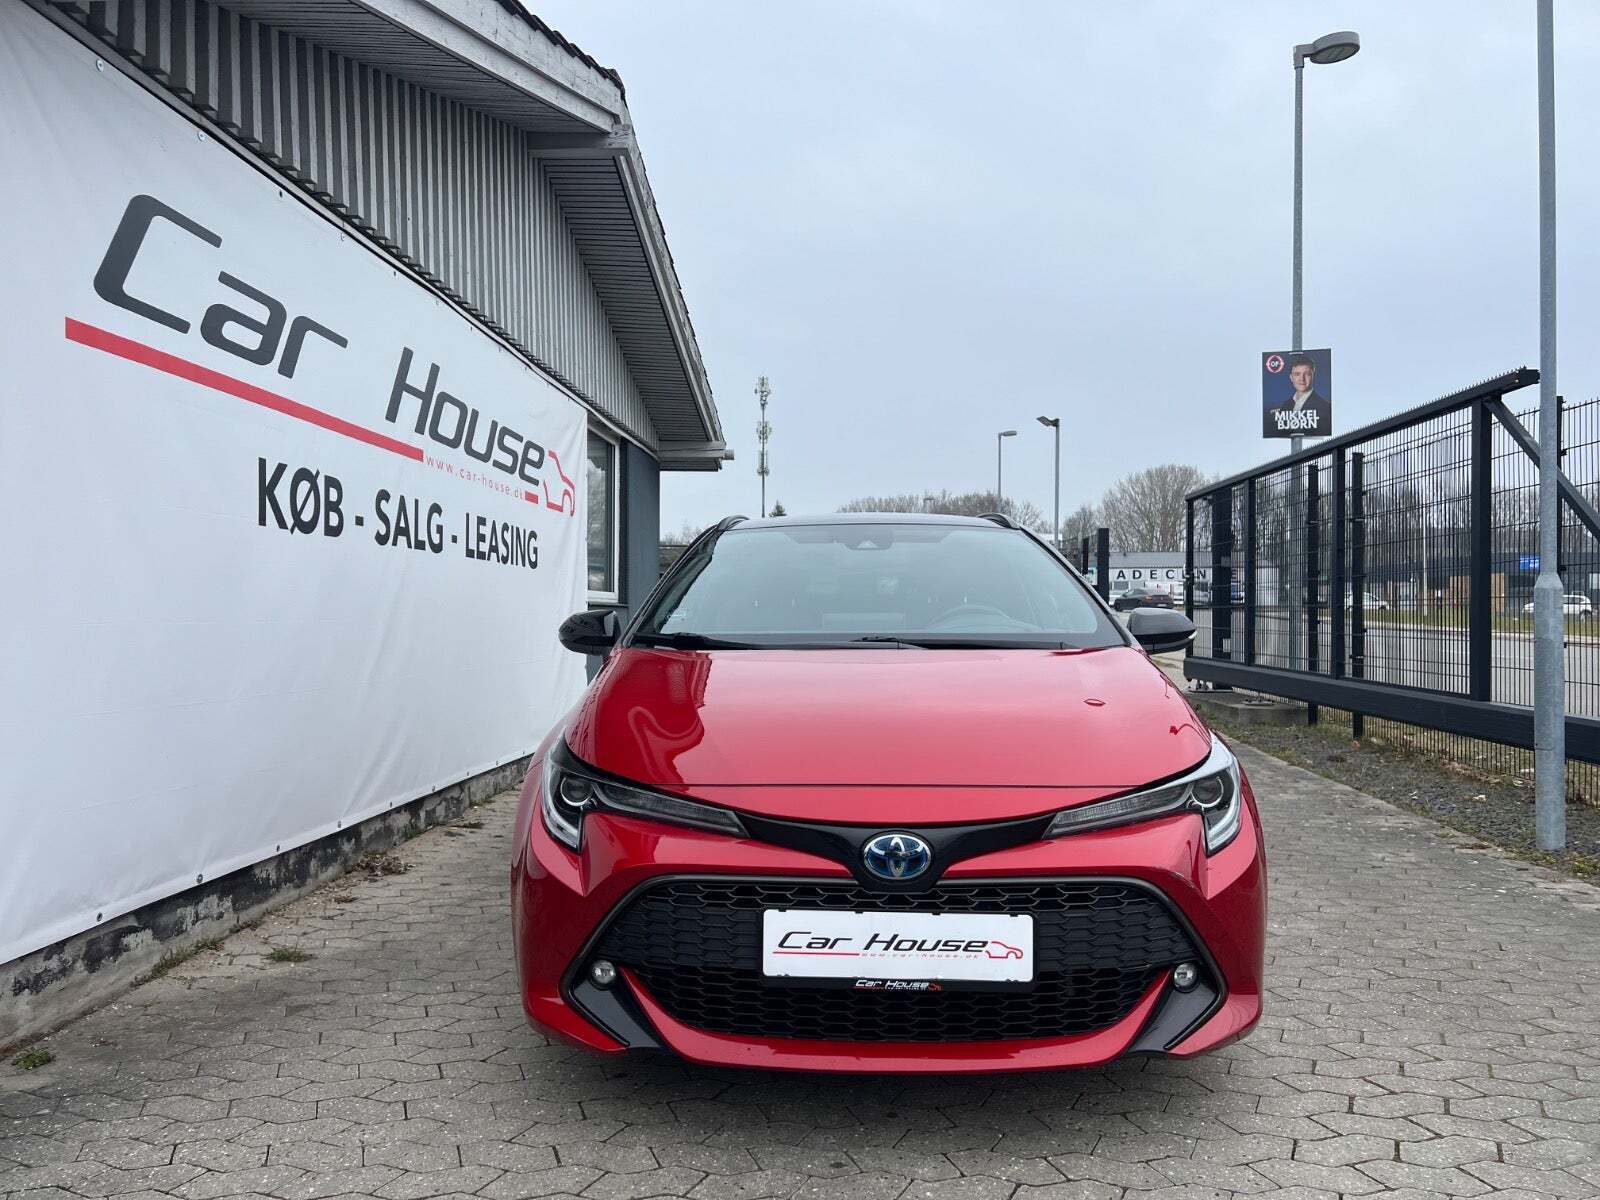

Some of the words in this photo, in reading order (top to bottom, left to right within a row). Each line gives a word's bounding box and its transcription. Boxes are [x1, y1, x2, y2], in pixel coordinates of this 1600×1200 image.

[94, 194, 348, 379] Car
[385, 346, 545, 487] House
[1274, 409, 1320, 421] MIKKEL
[1277, 419, 1318, 430] BJØRN
[258, 456, 344, 538] KØB
[374, 488, 444, 554] SALG
[465, 512, 538, 570] LEASING
[777, 931, 853, 950] Car
[863, 933, 989, 953] House
[855, 979, 882, 987] Car
[885, 980, 929, 988] House
